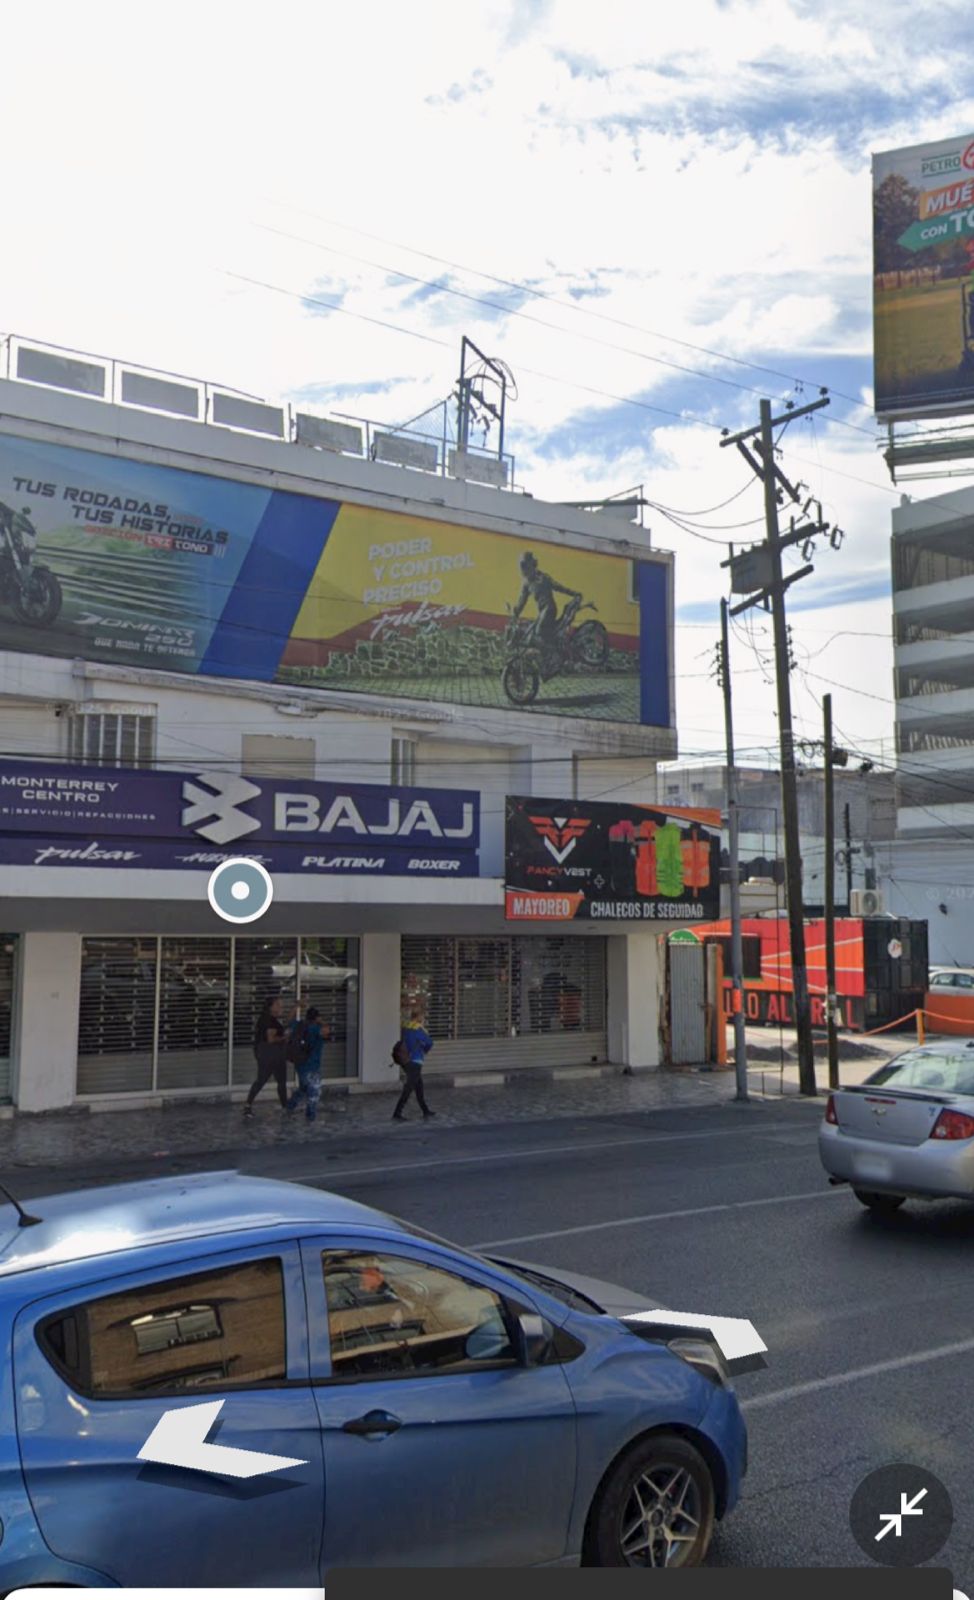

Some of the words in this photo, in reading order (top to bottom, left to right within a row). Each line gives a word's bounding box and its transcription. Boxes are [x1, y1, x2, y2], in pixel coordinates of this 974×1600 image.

[921, 157, 960, 173] PETRO
[920, 223, 948, 240] CON
[13, 477, 56, 498] TUS
[63, 486, 171, 521] RODADAS,
[72, 504, 114, 524] TUS
[121, 514, 229, 544] HISTORIAS
[368, 537, 433, 563] PODER
[373, 565, 385, 582] Y
[390, 551, 476, 580] CONTROL
[363, 578, 443, 609] PRECISO
[1, 775, 119, 792] MONTERREY
[22, 789, 101, 803] CENTRO
[274, 792, 474, 838] BAJAJ
[301, 855, 386, 869] PLATINA
[407, 858, 461, 871] BOXER
[513, 897, 571, 917] MAYOREO
[590, 901, 641, 918] CHALECOS
[643, 902, 656, 918] DE
